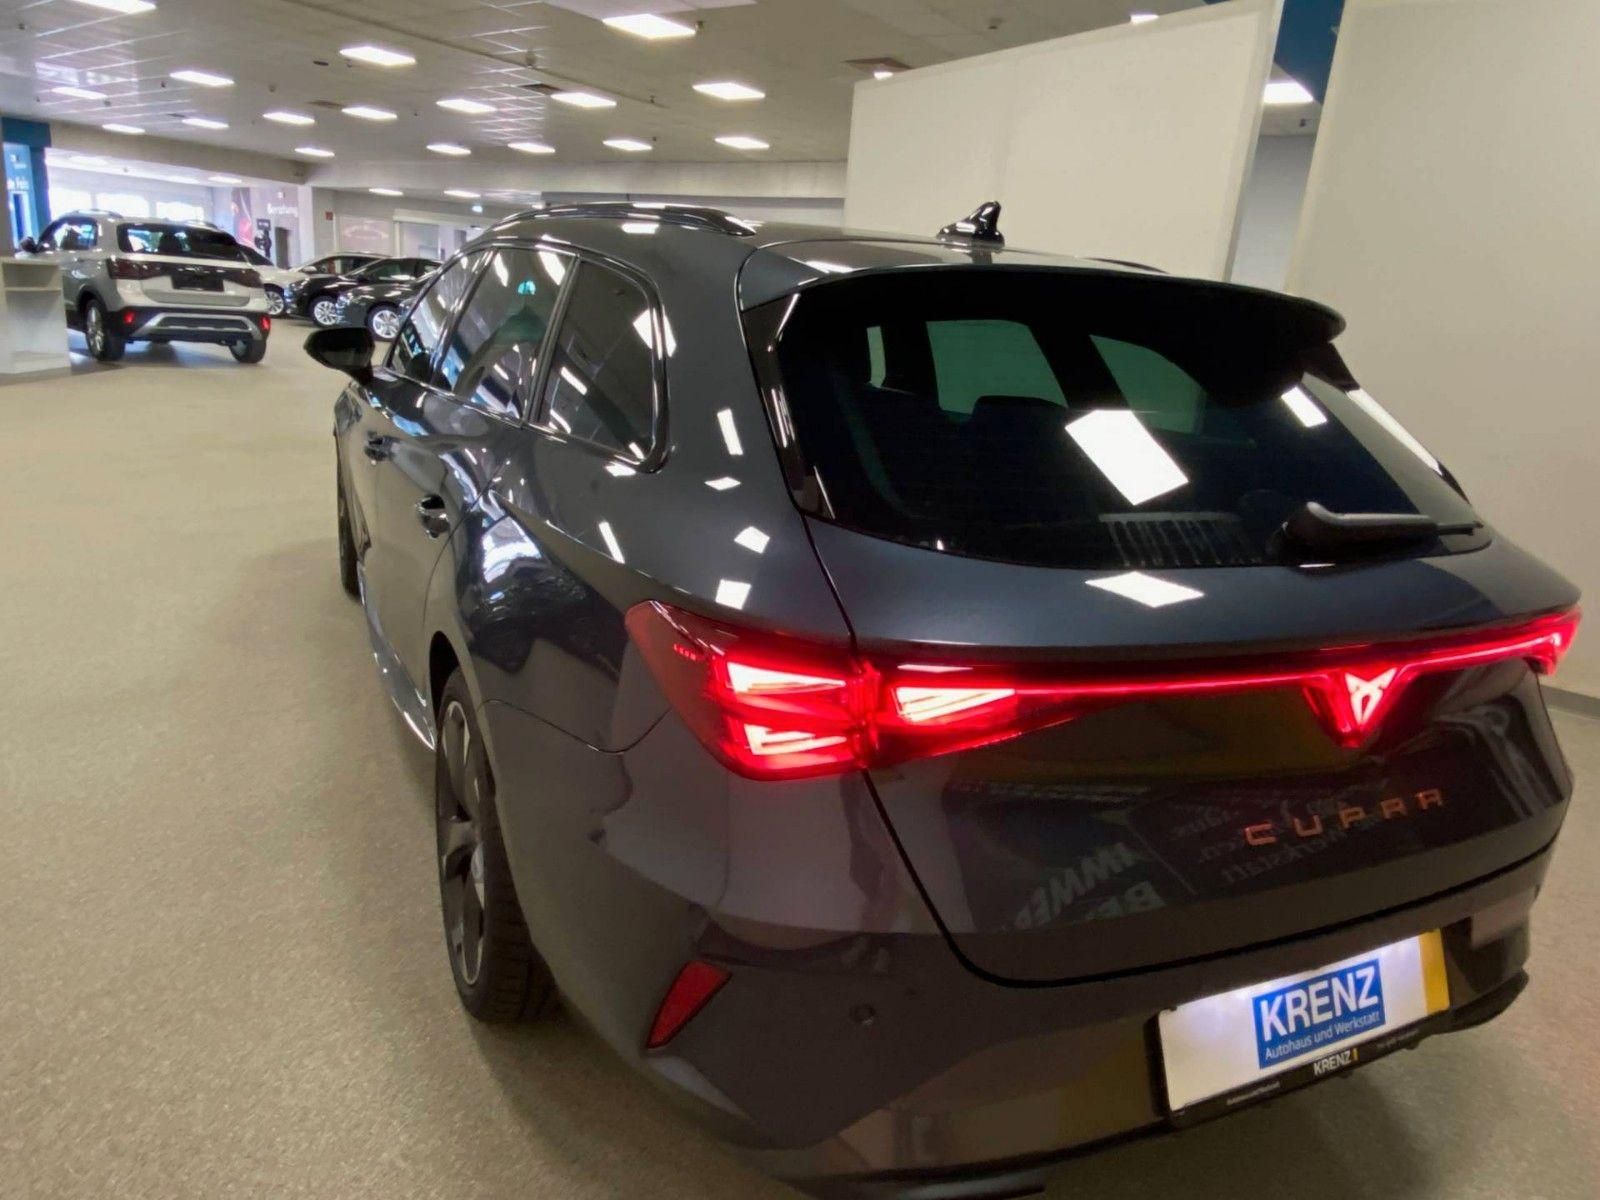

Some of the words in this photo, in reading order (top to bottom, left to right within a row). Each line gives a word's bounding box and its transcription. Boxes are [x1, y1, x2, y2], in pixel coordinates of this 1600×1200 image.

[1244, 788, 1444, 847] CUPRA
[1260, 966, 1379, 1042] KRENZ
[1265, 1033, 1313, 1061] Autohaus
[1314, 1026, 1334, 1043] und
[1334, 1011, 1380, 1035] Werkstatt
[1313, 1050, 1352, 1076] KRENZ
